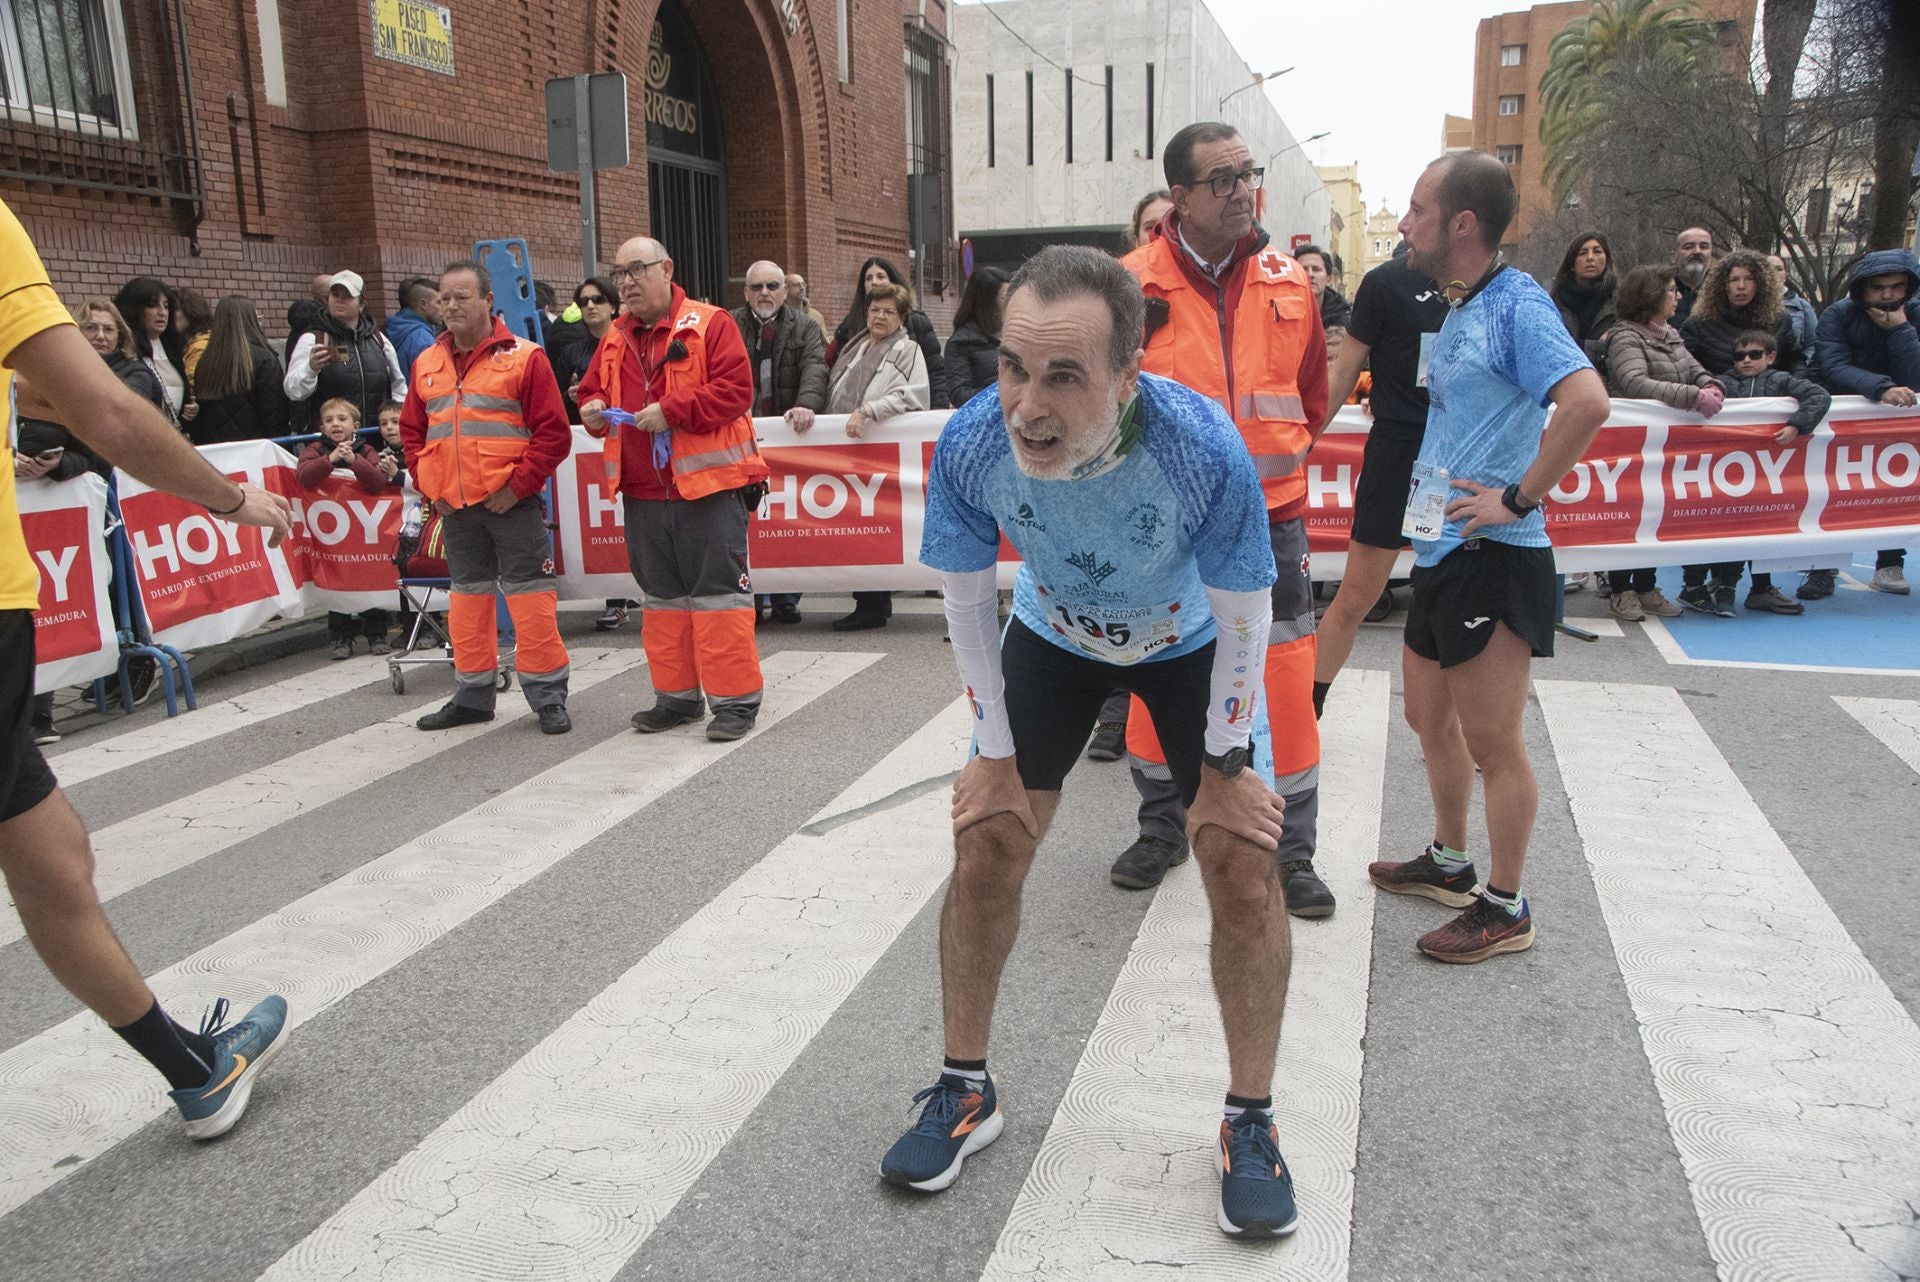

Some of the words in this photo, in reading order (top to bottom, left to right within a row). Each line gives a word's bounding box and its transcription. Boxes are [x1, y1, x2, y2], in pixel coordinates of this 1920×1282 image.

[399, 2, 427, 33] PASEO
[379, 23, 397, 51] SAN
[402, 30, 448, 65] FRANCISCO
[644, 89, 697, 133] RREOS
[1672, 448, 1797, 499] HOY
[1835, 442, 1920, 490] HO
[1548, 457, 1632, 504] OY
[757, 472, 888, 520] HOY
[1835, 499, 1870, 507] DIARIO
[1871, 497, 1885, 505] DE
[287, 496, 393, 546] HOY
[1309, 517, 1349, 527] DIARIO
[1555, 511, 1631, 522] EXTREMADURA
[1673, 507, 1708, 518] DIARIO
[1709, 506, 1723, 515] DE
[1725, 503, 1796, 515] EXTREMADURA
[759, 529, 796, 539] DIARIO
[797, 527, 812, 537] DE
[814, 525, 891, 536] EXTREMADURA
[1007, 514, 1046, 533] VIATOR
[1415, 524, 1433, 535] HO
[133, 514, 242, 581] HOY
[591, 536, 625, 545] DIARIO
[150, 582, 184, 600] DIARIO
[184, 577, 197, 589] DE
[34, 609, 88, 629] EMADURA
